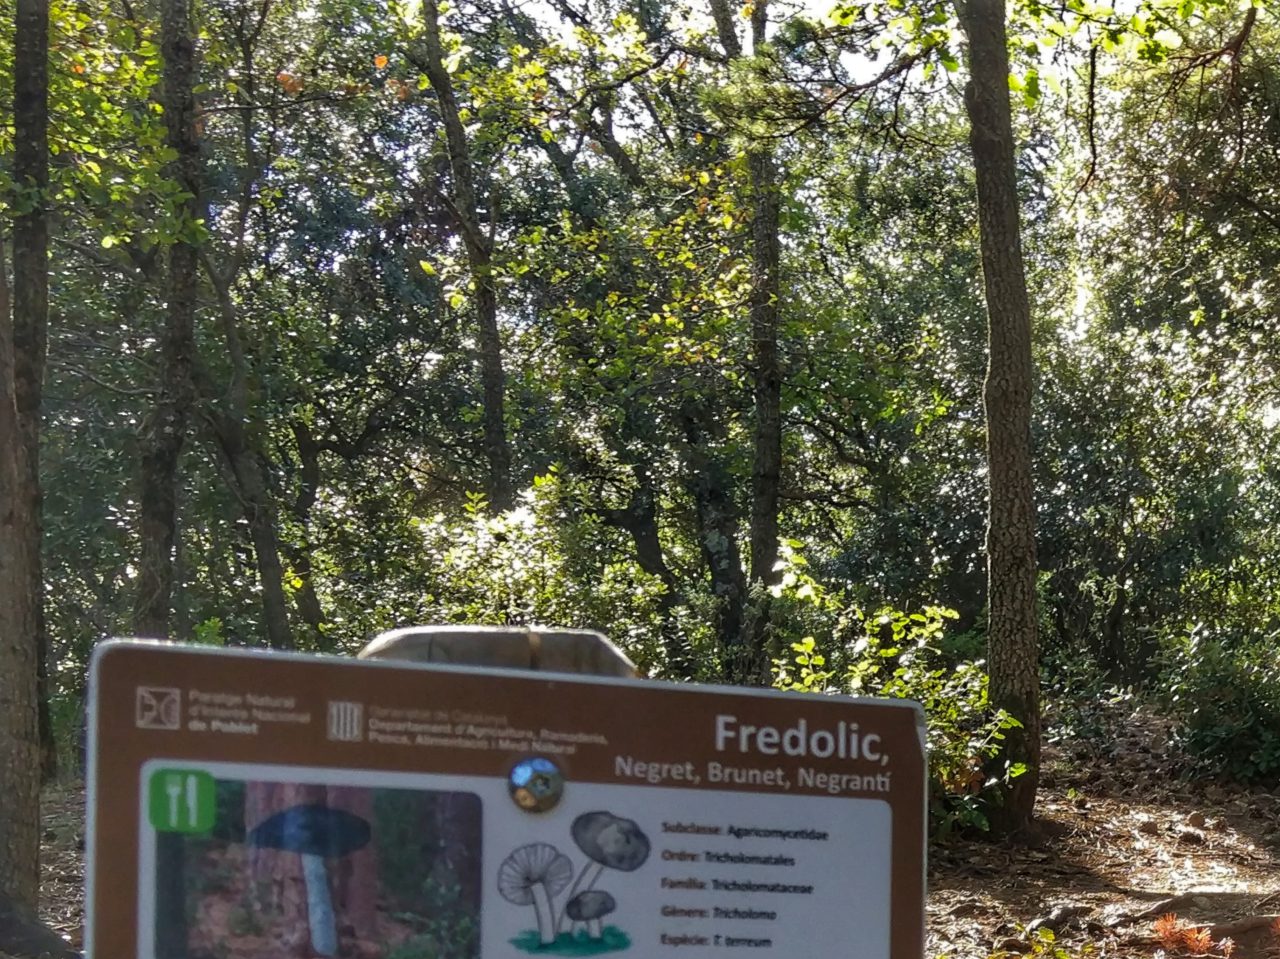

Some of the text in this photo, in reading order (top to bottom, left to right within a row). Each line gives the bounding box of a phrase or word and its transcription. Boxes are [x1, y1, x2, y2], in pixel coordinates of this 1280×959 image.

[714, 714, 890, 766] Fredolic,
[614, 755, 892, 794] Negret, Brunet, Negrantí
